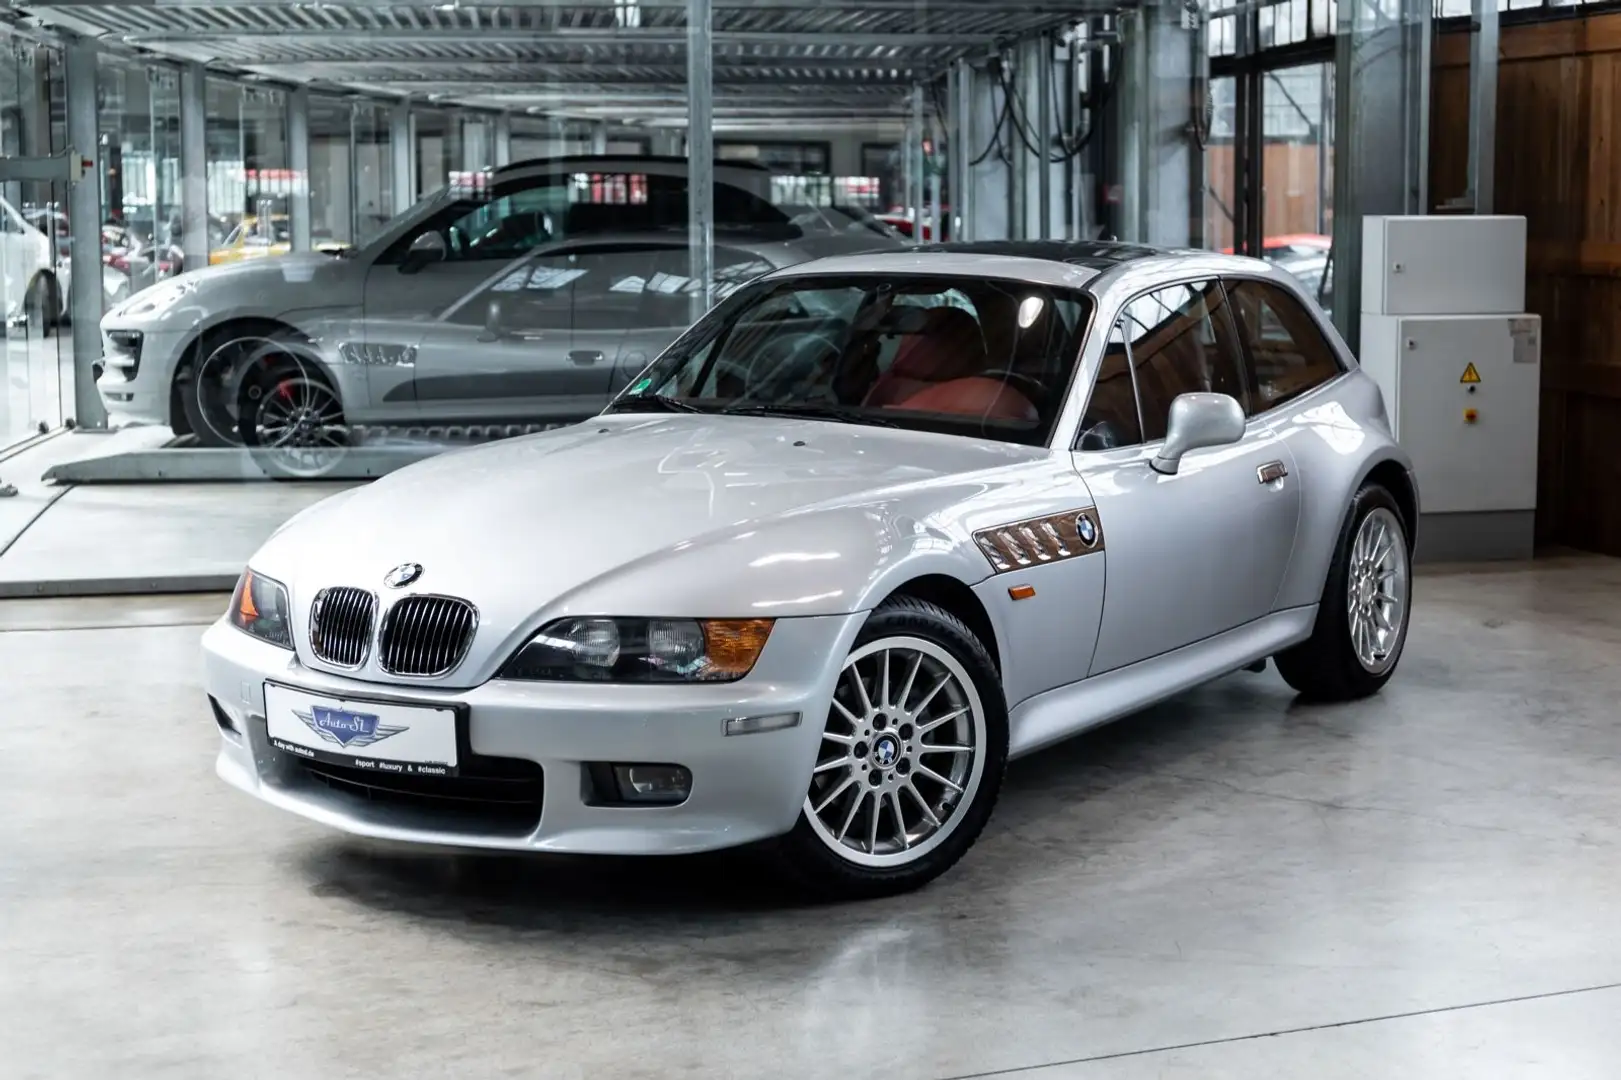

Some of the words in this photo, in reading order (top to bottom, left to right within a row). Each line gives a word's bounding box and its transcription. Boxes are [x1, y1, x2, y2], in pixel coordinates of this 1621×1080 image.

[319, 712, 347, 729] Auto
[350, 715, 369, 733] SL
[355, 758, 375, 768] #sport
[379, 762, 403, 772] #luxury
[407, 764, 413, 772] &
[417, 765, 446, 775] #classic
